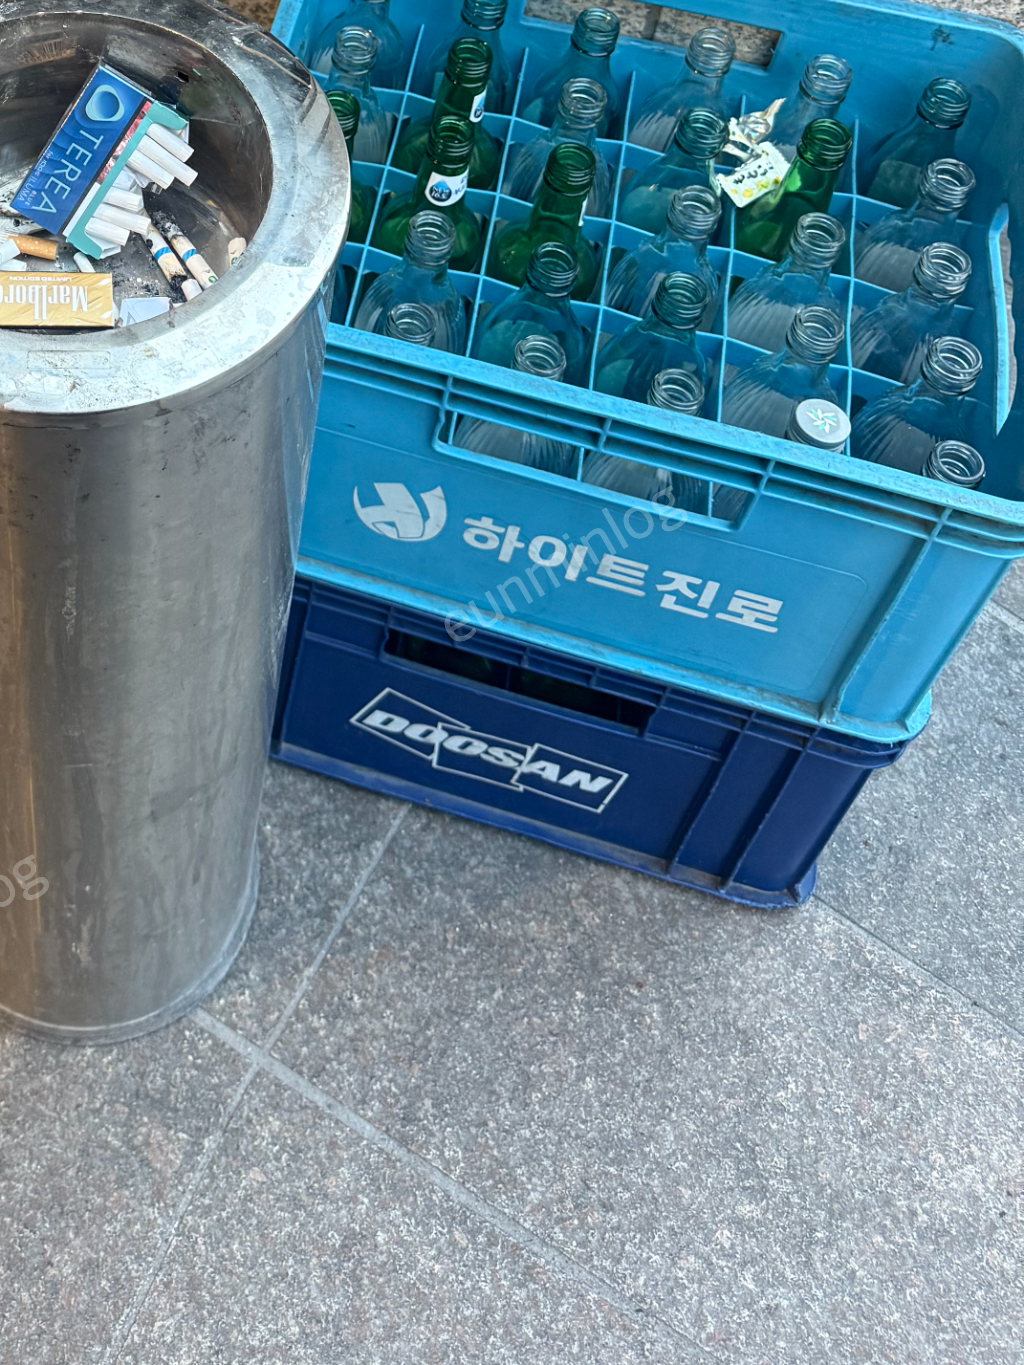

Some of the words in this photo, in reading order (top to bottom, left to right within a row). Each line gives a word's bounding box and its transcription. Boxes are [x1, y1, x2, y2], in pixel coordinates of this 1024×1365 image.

[31, 129, 104, 214] TEREA
[462, 515, 784, 634] 하이트진로
[362, 709, 614, 794] DOOSAN
